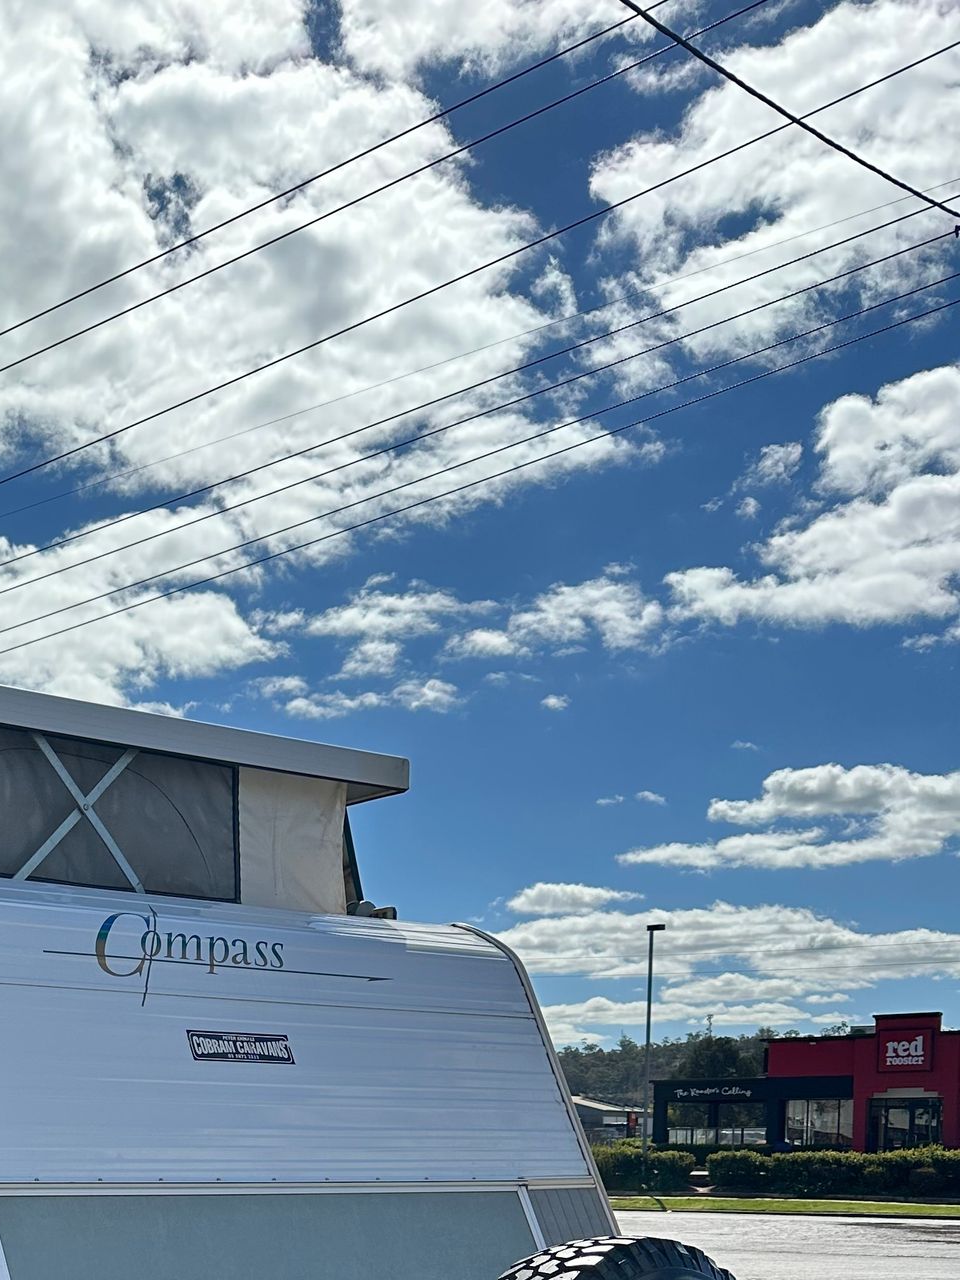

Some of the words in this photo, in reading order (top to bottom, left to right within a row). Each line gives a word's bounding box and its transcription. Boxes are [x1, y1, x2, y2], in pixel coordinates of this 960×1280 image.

[95, 911, 285, 977] Compass
[192, 1035, 235, 1055] COBRAM
[236, 1040, 289, 1059] CARAVANS
[886, 1035, 924, 1056] red
[886, 1056, 924, 1065] rooster
[674, 1089, 689, 1098] The
[721, 1086, 752, 1097] Calling
